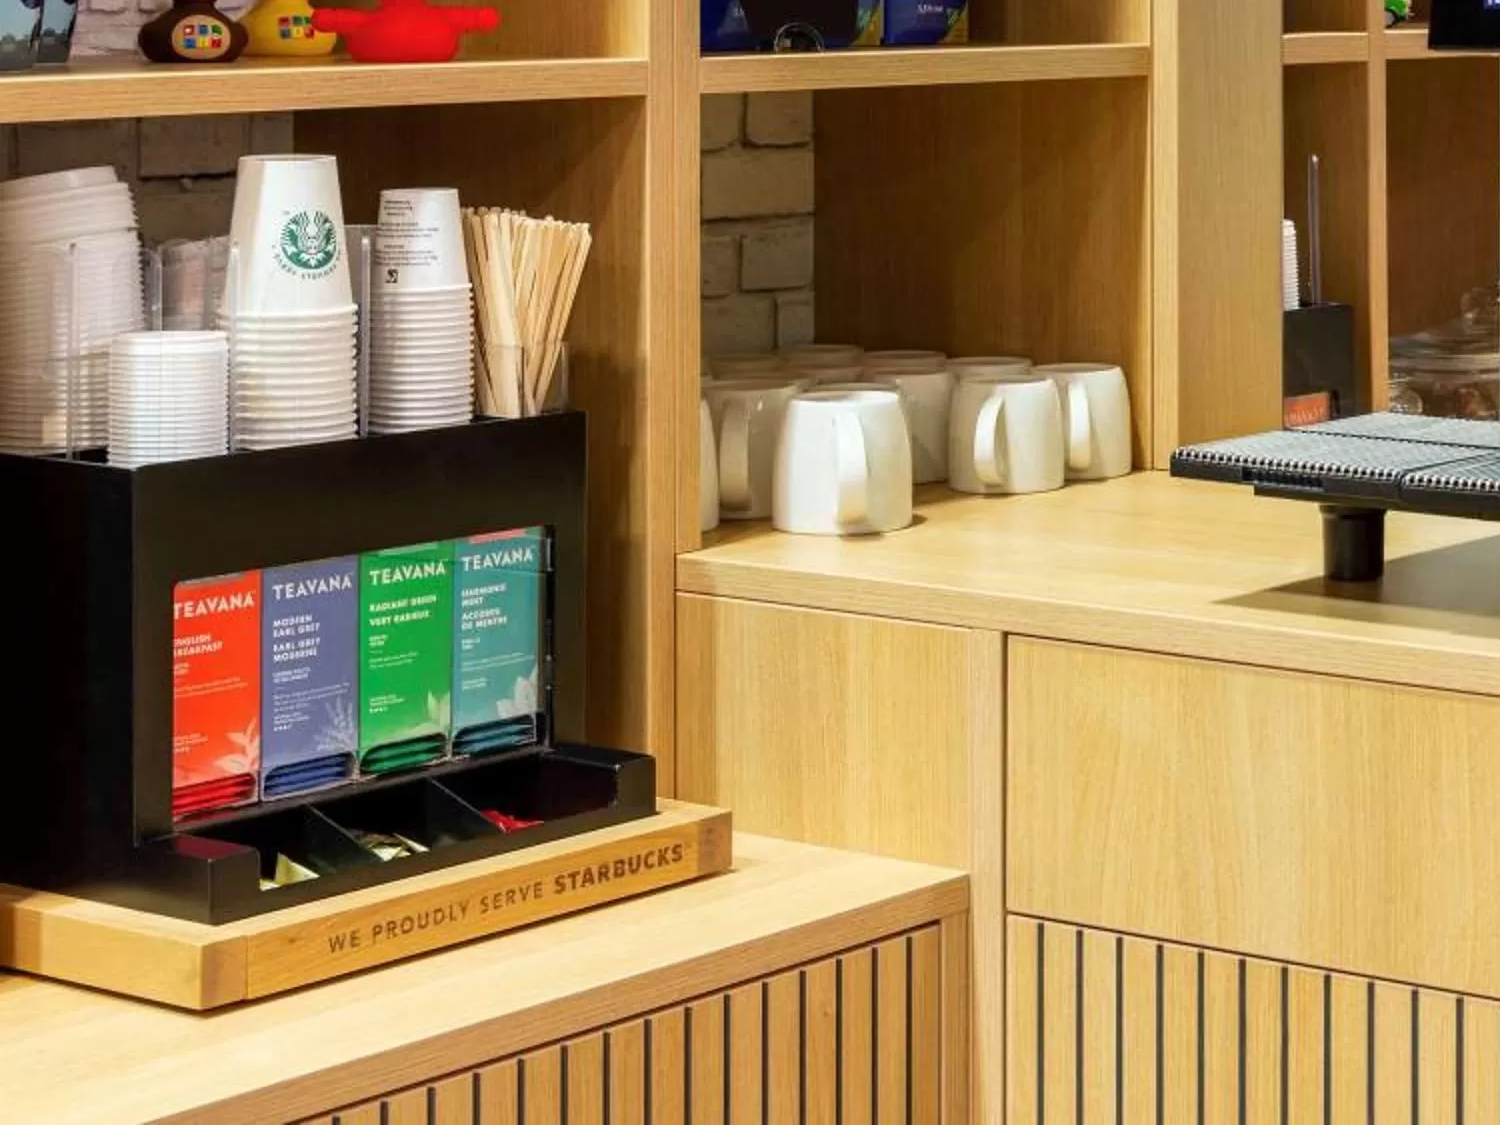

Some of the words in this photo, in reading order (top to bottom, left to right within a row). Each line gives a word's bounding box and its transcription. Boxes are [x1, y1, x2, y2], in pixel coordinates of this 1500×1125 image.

[460, 547, 533, 572] TEAVANA
[369, 562, 446, 586] TEAVANA
[272, 575, 352, 600] TEAVANA
[173, 592, 255, 620] TEAVANA
[327, 932, 362, 955] WE
[371, 899, 471, 945] PROUDLY
[479, 881, 544, 914] SERVE
[553, 843, 684, 895] STARBUCKS
